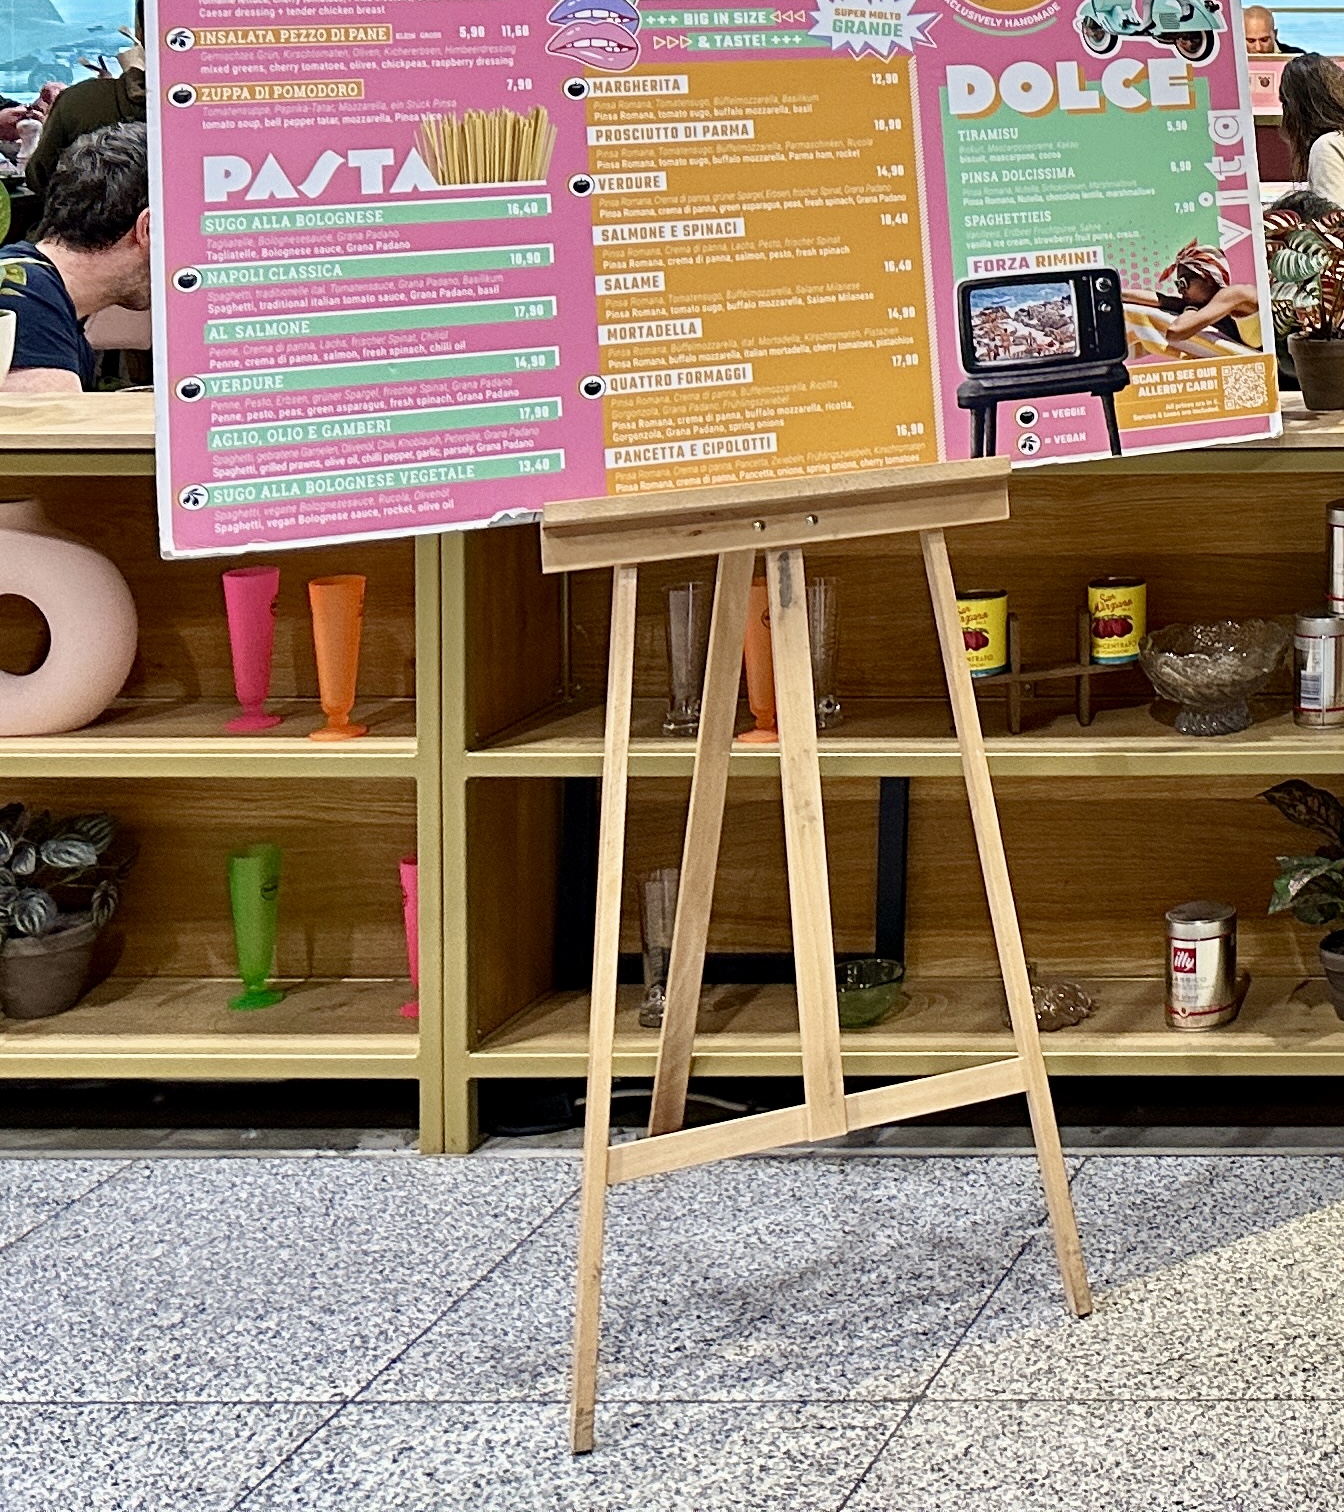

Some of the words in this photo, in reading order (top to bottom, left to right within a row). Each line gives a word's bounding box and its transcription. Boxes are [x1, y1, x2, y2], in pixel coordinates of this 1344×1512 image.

[684, 12, 709, 26] BIG
[714, 11, 729, 25] IN
[733, 11, 767, 24] SIZE
[834, 8, 866, 18] SUPER
[868, 10, 901, 20] MOLTO
[1005, 1, 1061, 28] HANDMADE
[200, 30, 274, 44] INSALATA
[280, 29, 326, 42] PEZZO
[330, 29, 345, 41] DI
[349, 27, 387, 41] PANE
[460, 26, 485, 39] 5,90
[501, 25, 530, 37] 11,60
[832, 19, 903, 38] GRANDE
[698, 35, 710, 48] &
[714, 34, 766, 47] TASTE!
[201, 86, 251, 100] ZUPPA
[255, 86, 270, 99] DI
[274, 83, 358, 99] POMODORO
[507, 78, 532, 93] 7,90
[593, 79, 681, 94] MARGHERITA
[946, 58, 1194, 118] DOLCE
[596, 127, 678, 142] PROSCIUTTO
[685, 126, 697, 138] DI
[703, 124, 749, 137] PARMA
[958, 128, 1018, 142] TIRAMISU
[203, 147, 441, 202] PASTA
[598, 175, 660, 191] VERDURE
[961, 172, 998, 184] PINSA
[1002, 167, 1076, 181] DOLCISSIMA
[205, 217, 247, 232] SUGO
[252, 215, 291, 229] ALLA
[296, 210, 384, 227] BOLOGNESE
[507, 202, 538, 216] 16,40
[964, 210, 1052, 227] SPAGHETTIEIS
[1174, 202, 1195, 214] 7,90
[602, 226, 665, 242] SALMONE
[671, 225, 678, 237] E
[683, 221, 737, 237] SPINACI
[973, 257, 1030, 273] FORZA
[1036, 250, 1098, 268] RIMINI!
[207, 269, 264, 285] NAPOLI
[269, 264, 343, 281] CLASSICA
[604, 275, 660, 291] SALAME
[209, 327, 227, 340] AL
[235, 321, 310, 337] SALMONE
[514, 305, 544, 319] 17,90
[607, 321, 697, 341] MORTADELLA
[210, 376, 284, 393] VERDURE
[610, 373, 672, 391] QUATTRO
[677, 367, 747, 383] FORMAGGI
[1132, 373, 1160, 385] SCAN
[1161, 371, 1175, 382] TO
[1177, 370, 1195, 380] SEE
[1197, 367, 1217, 379] OUR
[1138, 383, 1184, 398] ALLERGY
[1186, 380, 1218, 392] CARD!
[1052, 407, 1086, 418] VEGGIE
[212, 431, 263, 448] AGLIO,
[267, 428, 303, 443] OLIO
[308, 427, 317, 439] E
[322, 419, 391, 438] GAMBERI
[1054, 432, 1087, 444] VEGAN
[615, 445, 685, 464] PANCETTA
[690, 443, 697, 456] E
[702, 437, 771, 455] CIPOLOTTI
[214, 488, 255, 503] SUGO
[261, 485, 300, 499] ALLA
[306, 473, 395, 493] BOLOGNESE
[400, 465, 475, 485] VEGETALE
[1175, 951, 1195, 971] illy
